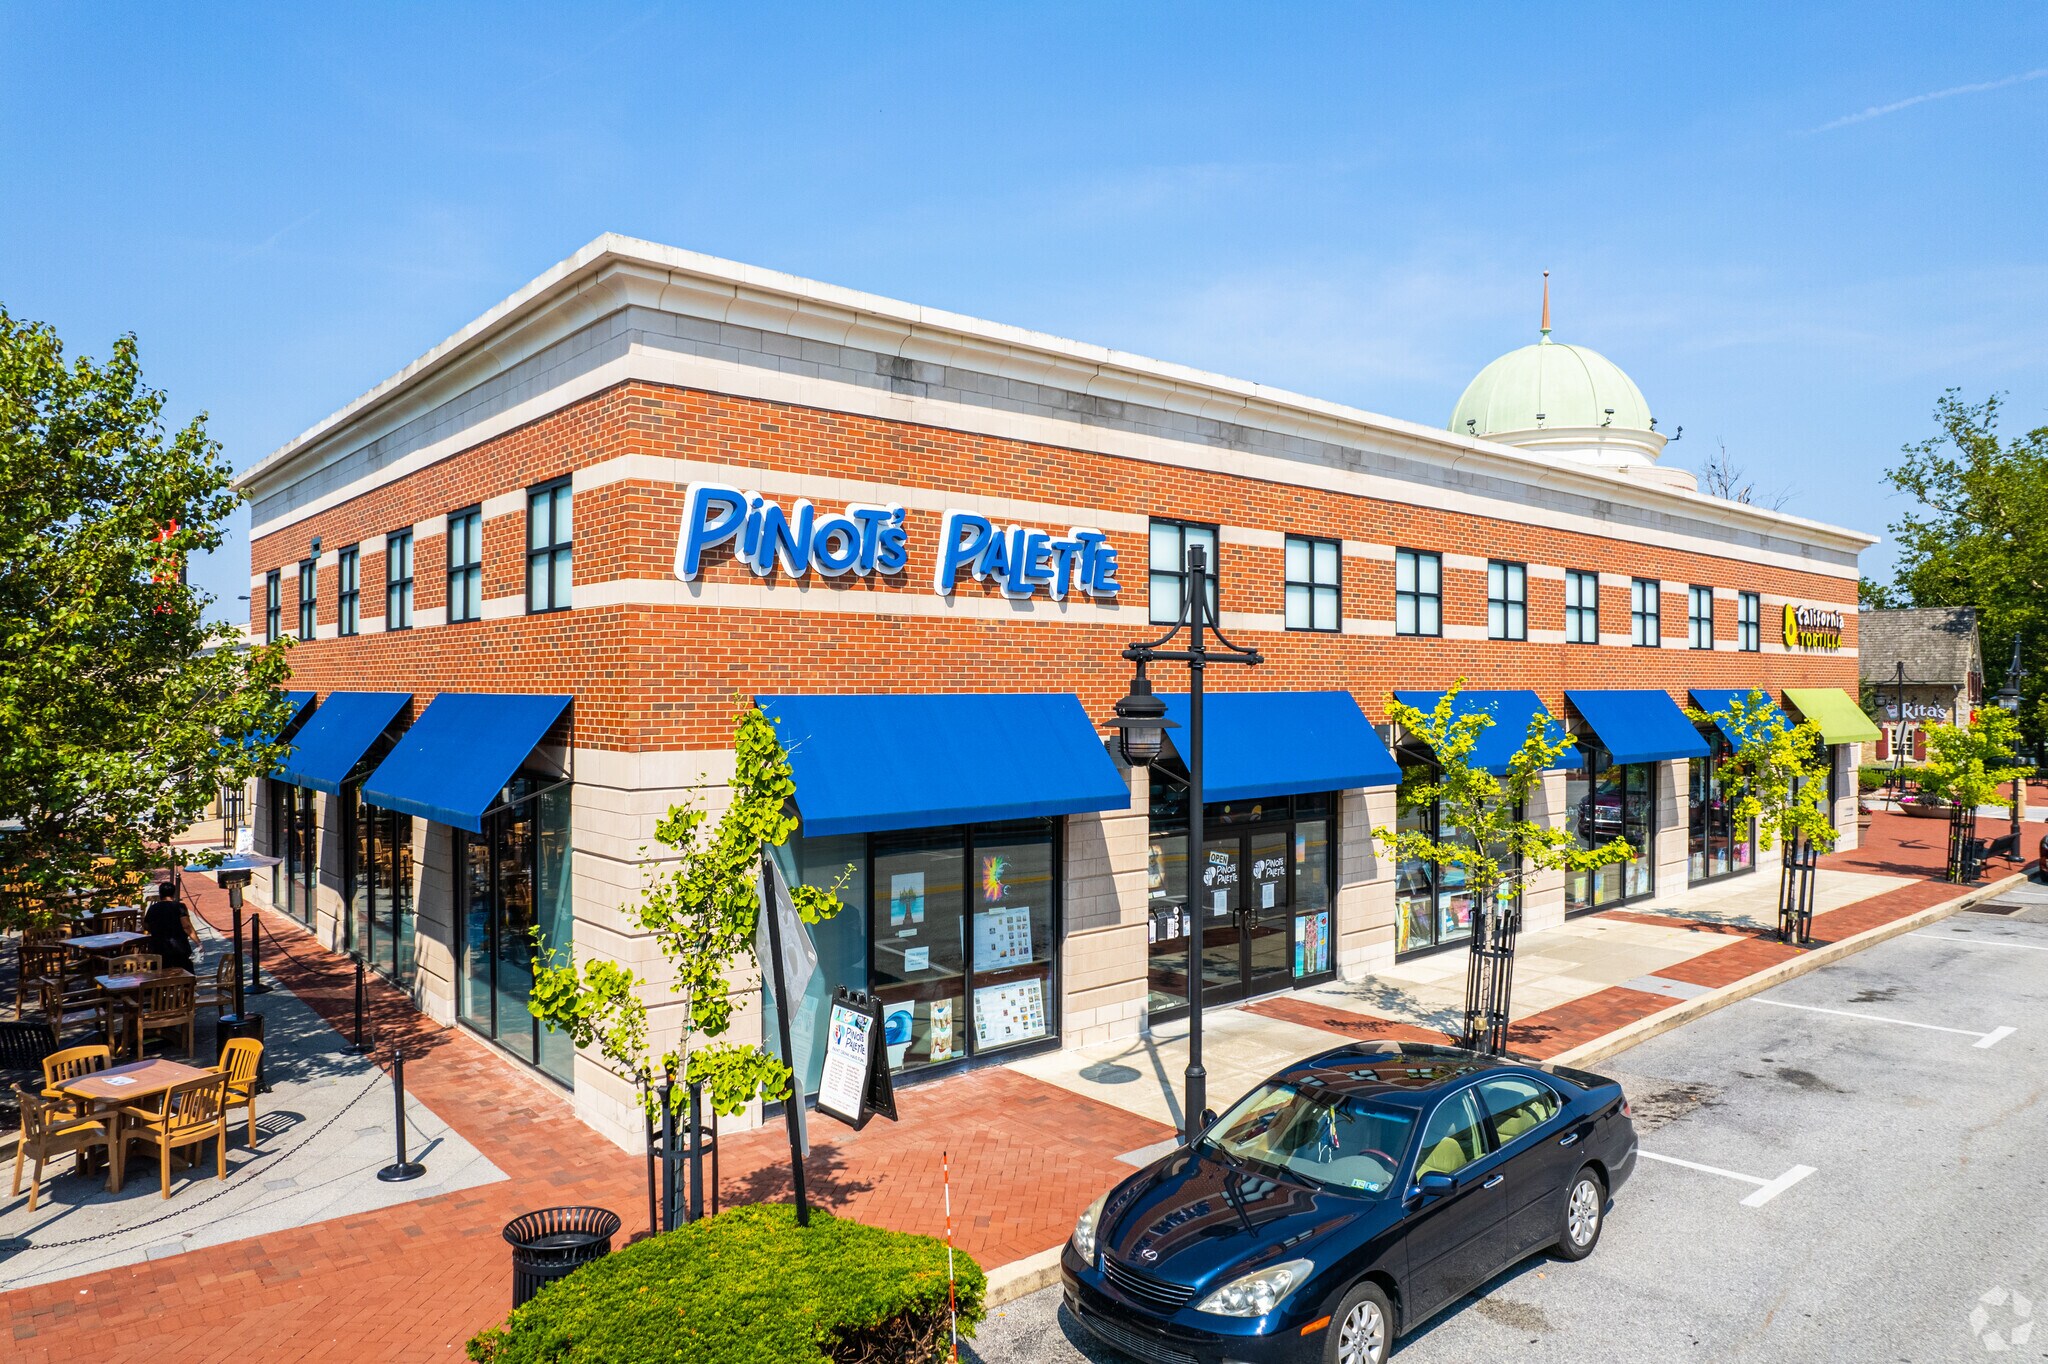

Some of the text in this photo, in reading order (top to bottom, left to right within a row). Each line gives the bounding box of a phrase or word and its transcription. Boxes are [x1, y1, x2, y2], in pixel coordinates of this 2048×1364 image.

[935, 511, 1122, 600] PALETTE
[1796, 605, 1845, 629] California
[1800, 632, 1843, 648] TORTILLA
[1902, 702, 1947, 719] Rita's
[1211, 853, 1228, 865] OPEN
